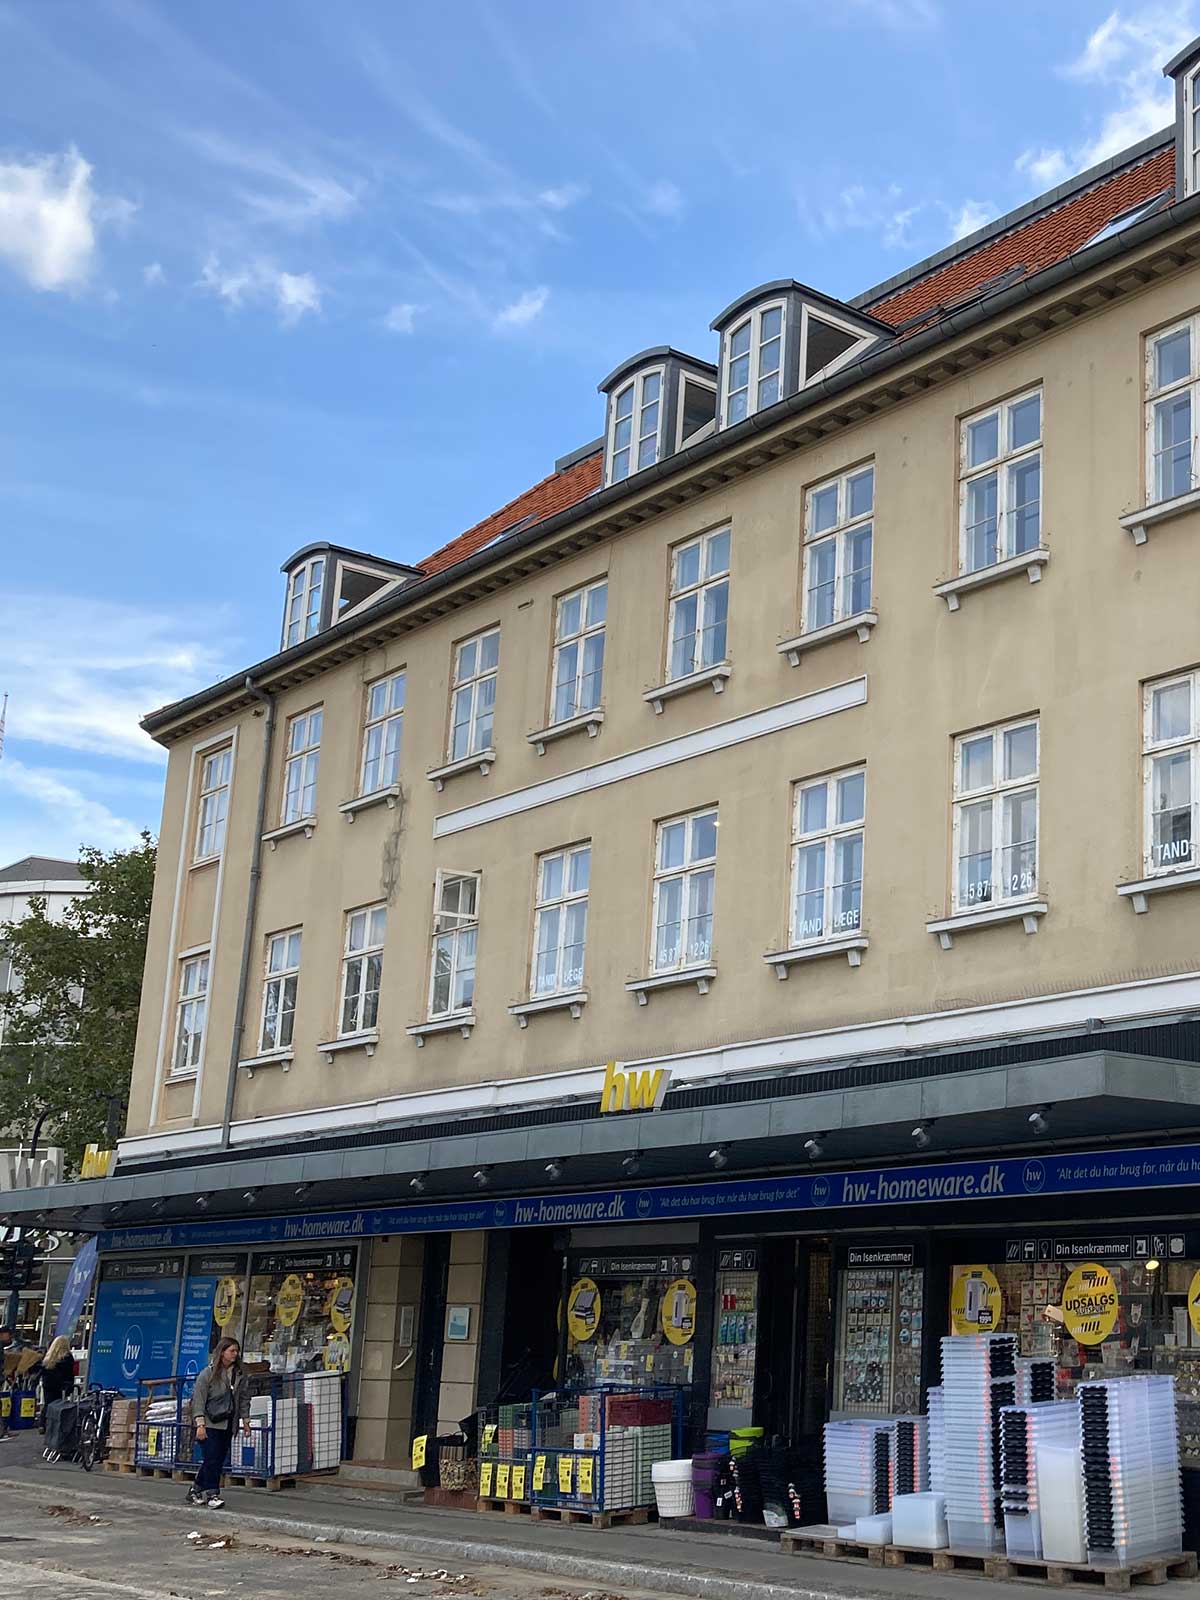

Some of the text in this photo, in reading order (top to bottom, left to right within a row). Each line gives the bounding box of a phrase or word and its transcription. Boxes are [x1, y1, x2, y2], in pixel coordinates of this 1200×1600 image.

[1153, 839, 1189, 861] TAND
[600, 1060, 670, 1112] hw
[842, 1165, 1006, 1203] hw-homeware.dk
[1026, 1165, 1042, 1182] hw
[1073, 1165, 1088, 1179] det
[1090, 1164, 1101, 1178] du
[1103, 1163, 1118, 1177] har
[1120, 1162, 1140, 1178] brug
[1159, 1159, 1175, 1173] når
[1177, 1158, 1189, 1172] du
[514, 1195, 626, 1223] hw-homeware.dk
[284, 1213, 365, 1237] hw-homeware.dk
[862, 1251, 911, 1262] Isenkræmmer
[1056, 1243, 1130, 1255] Din Isenkræmmer
[1065, 1294, 1115, 1311] UDSALGS
[124, 1338, 141, 1360] hw
